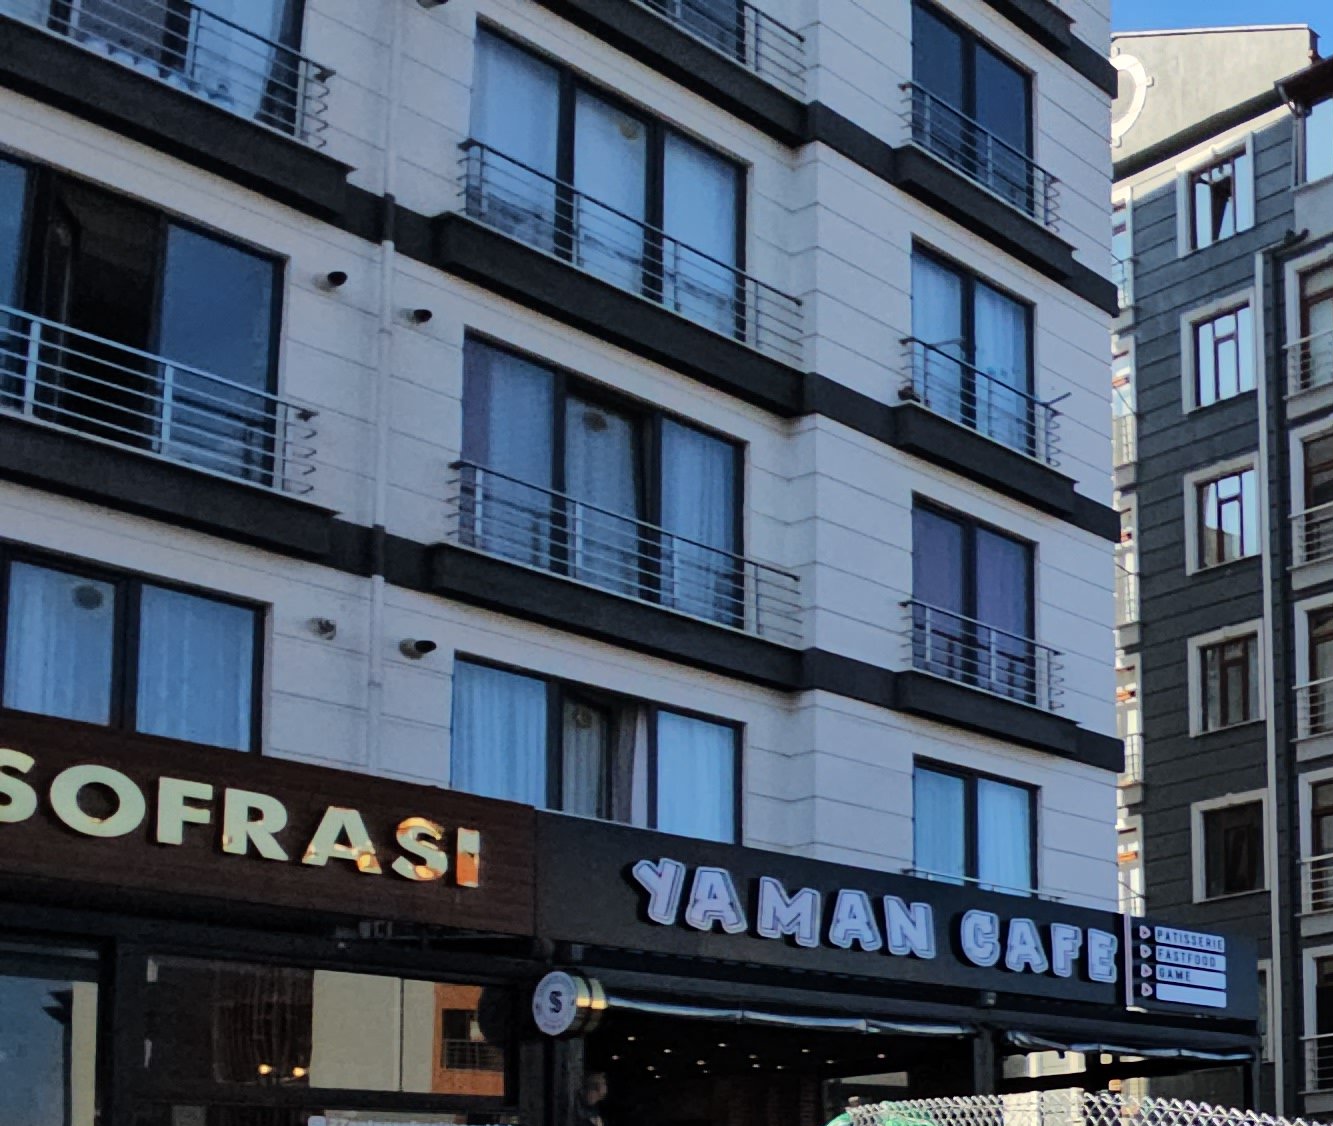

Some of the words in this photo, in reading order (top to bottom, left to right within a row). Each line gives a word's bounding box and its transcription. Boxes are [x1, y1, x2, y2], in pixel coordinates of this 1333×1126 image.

[632, 858, 936, 959] YAMAN
[960, 910, 1119, 983] CAFE
[1157, 930, 1222, 950] PATISSERIE
[1158, 949, 1216, 968] FASTFOOD
[1159, 967, 1191, 982] GAME
